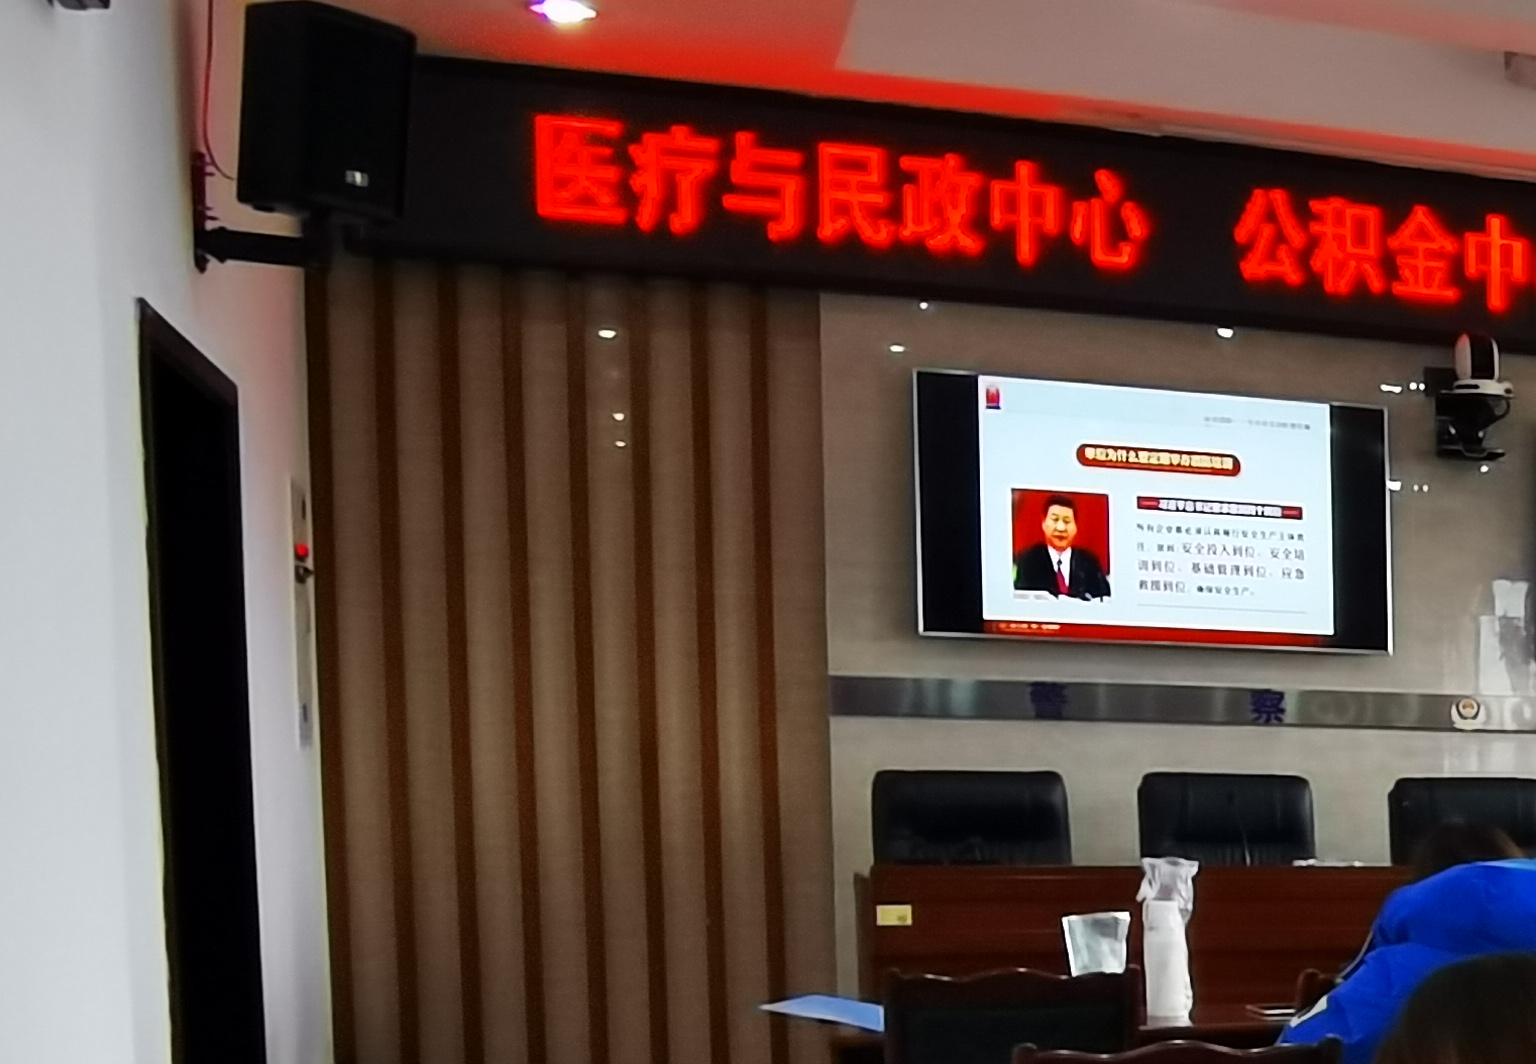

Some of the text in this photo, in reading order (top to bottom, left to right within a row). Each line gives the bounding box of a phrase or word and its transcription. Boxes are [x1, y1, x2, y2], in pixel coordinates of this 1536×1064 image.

[534, 113, 1148, 270] 医疗与民政中心
